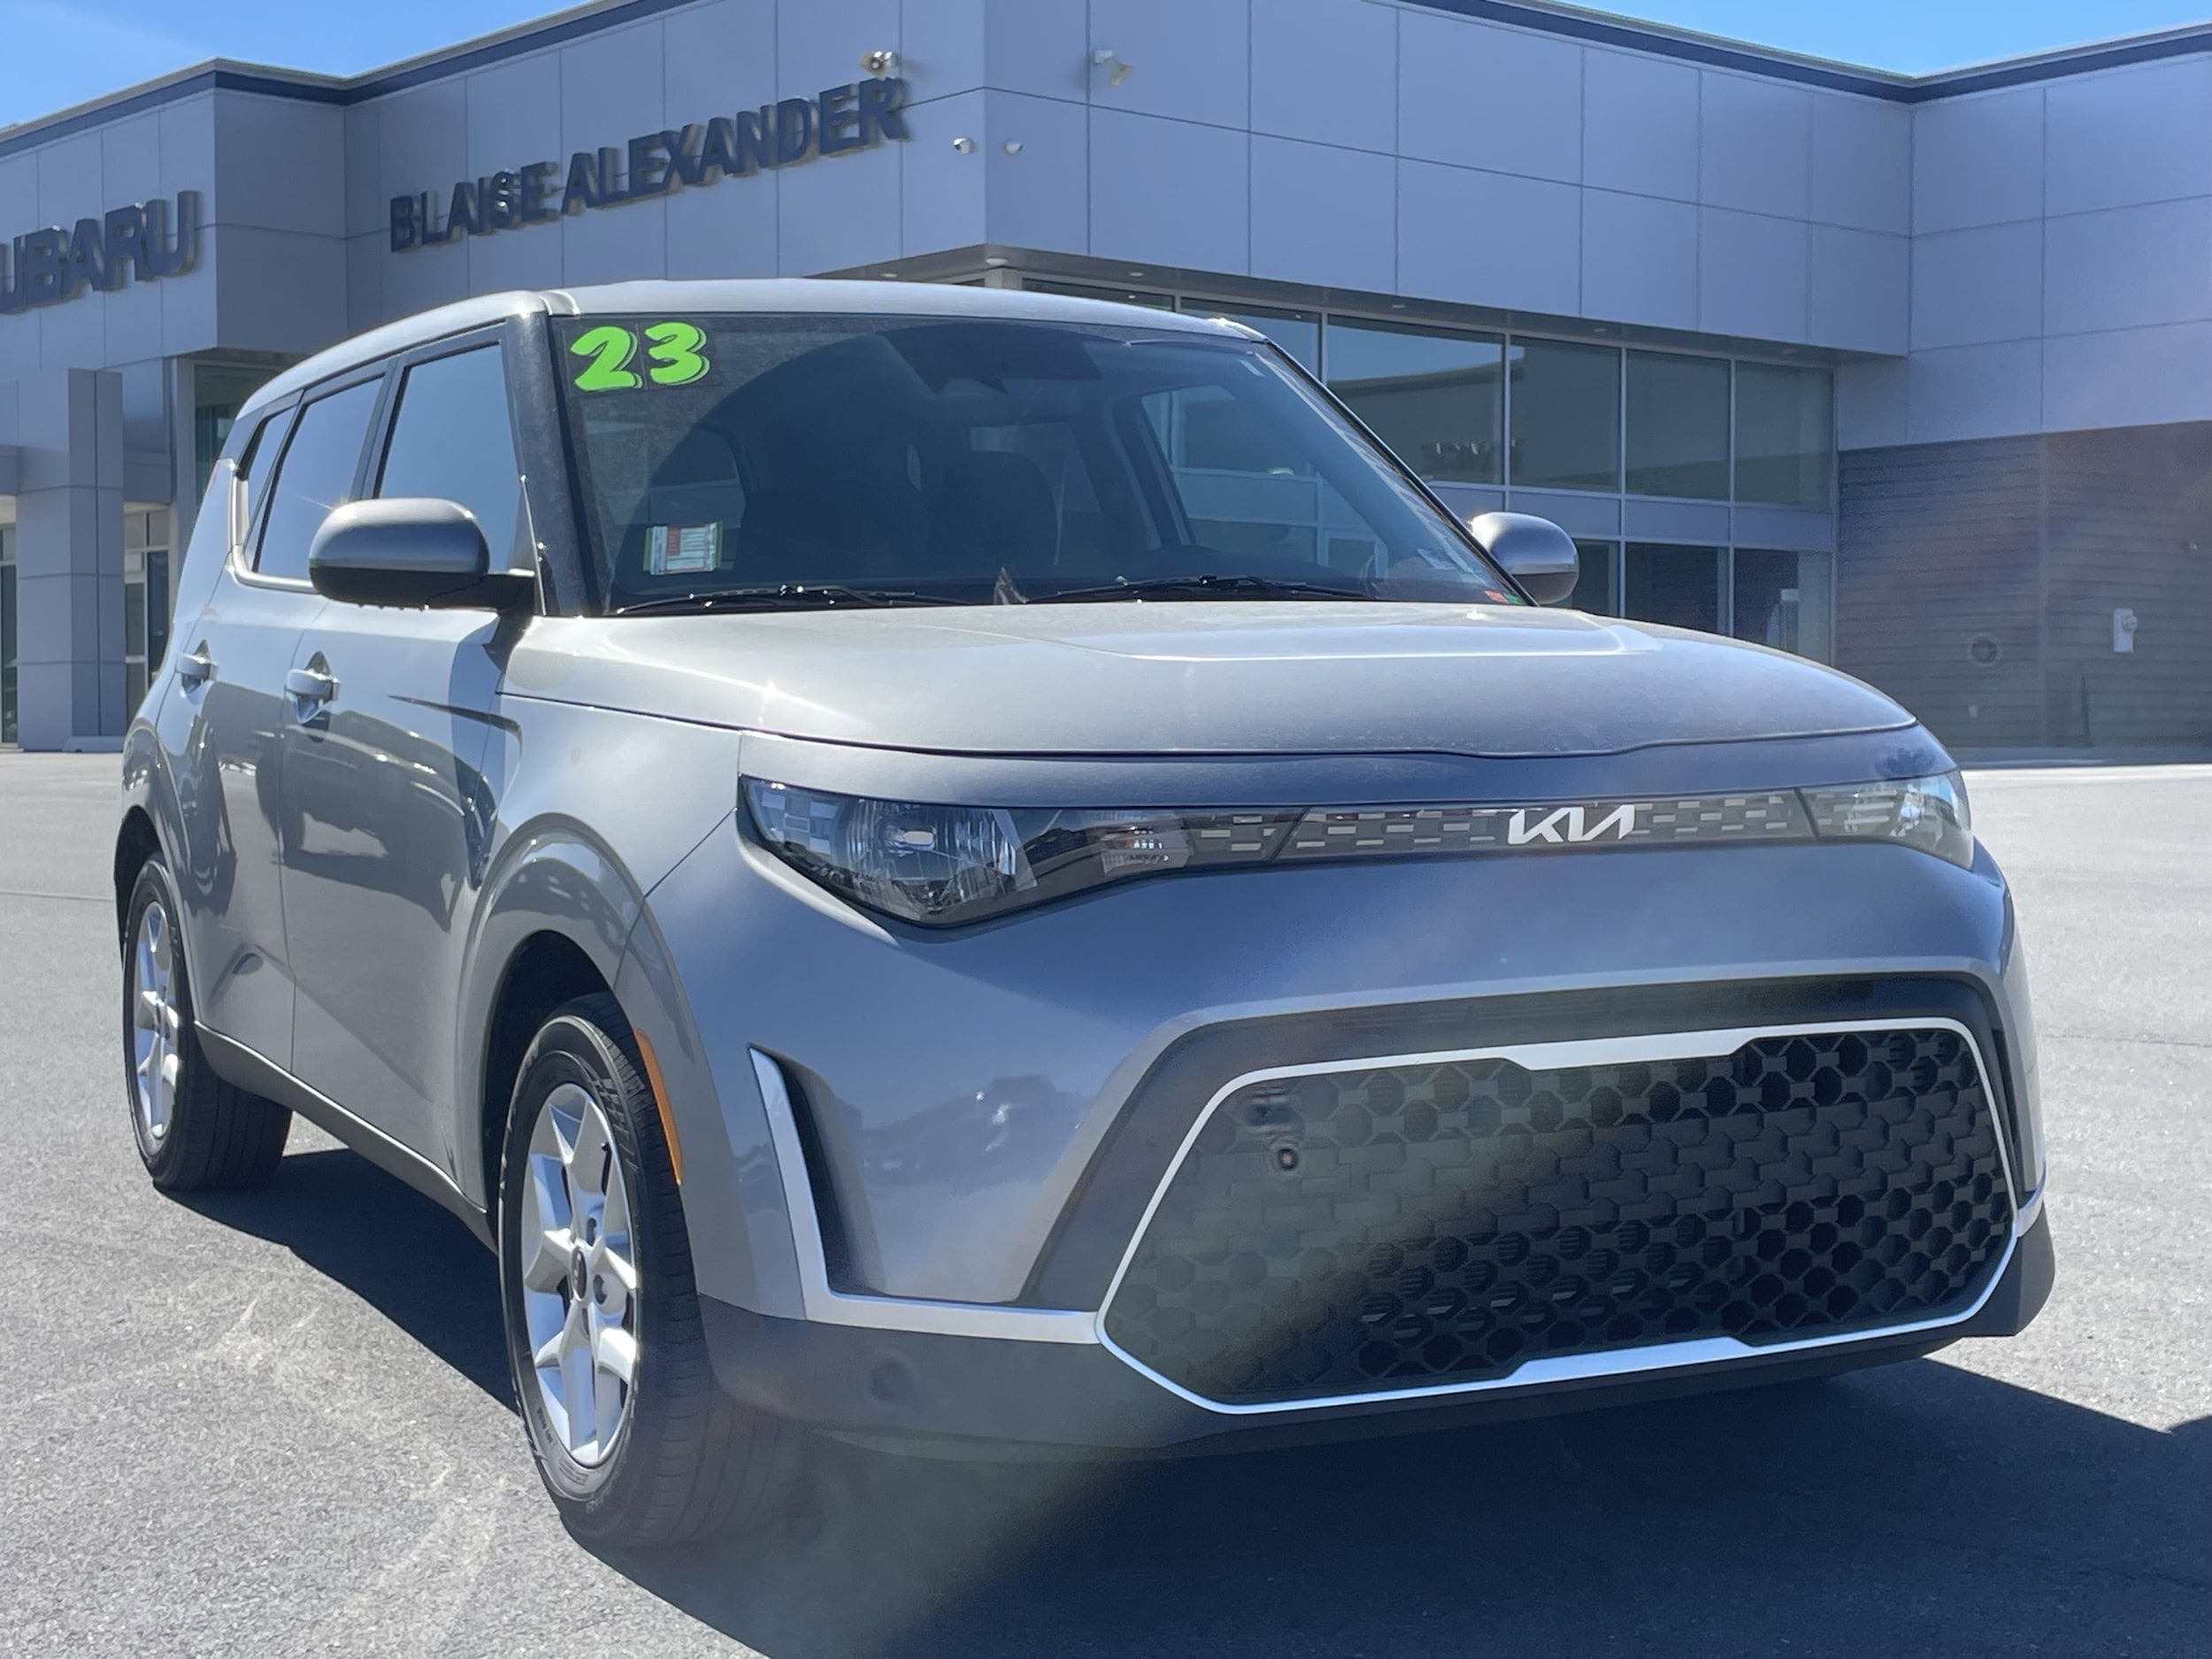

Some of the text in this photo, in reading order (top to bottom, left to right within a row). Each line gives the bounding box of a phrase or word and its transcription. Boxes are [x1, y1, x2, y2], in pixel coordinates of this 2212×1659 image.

[390, 76, 910, 254] BLAISE ALEXANDER
[570, 321, 710, 391] 23
[1508, 804, 1634, 844] KIA
